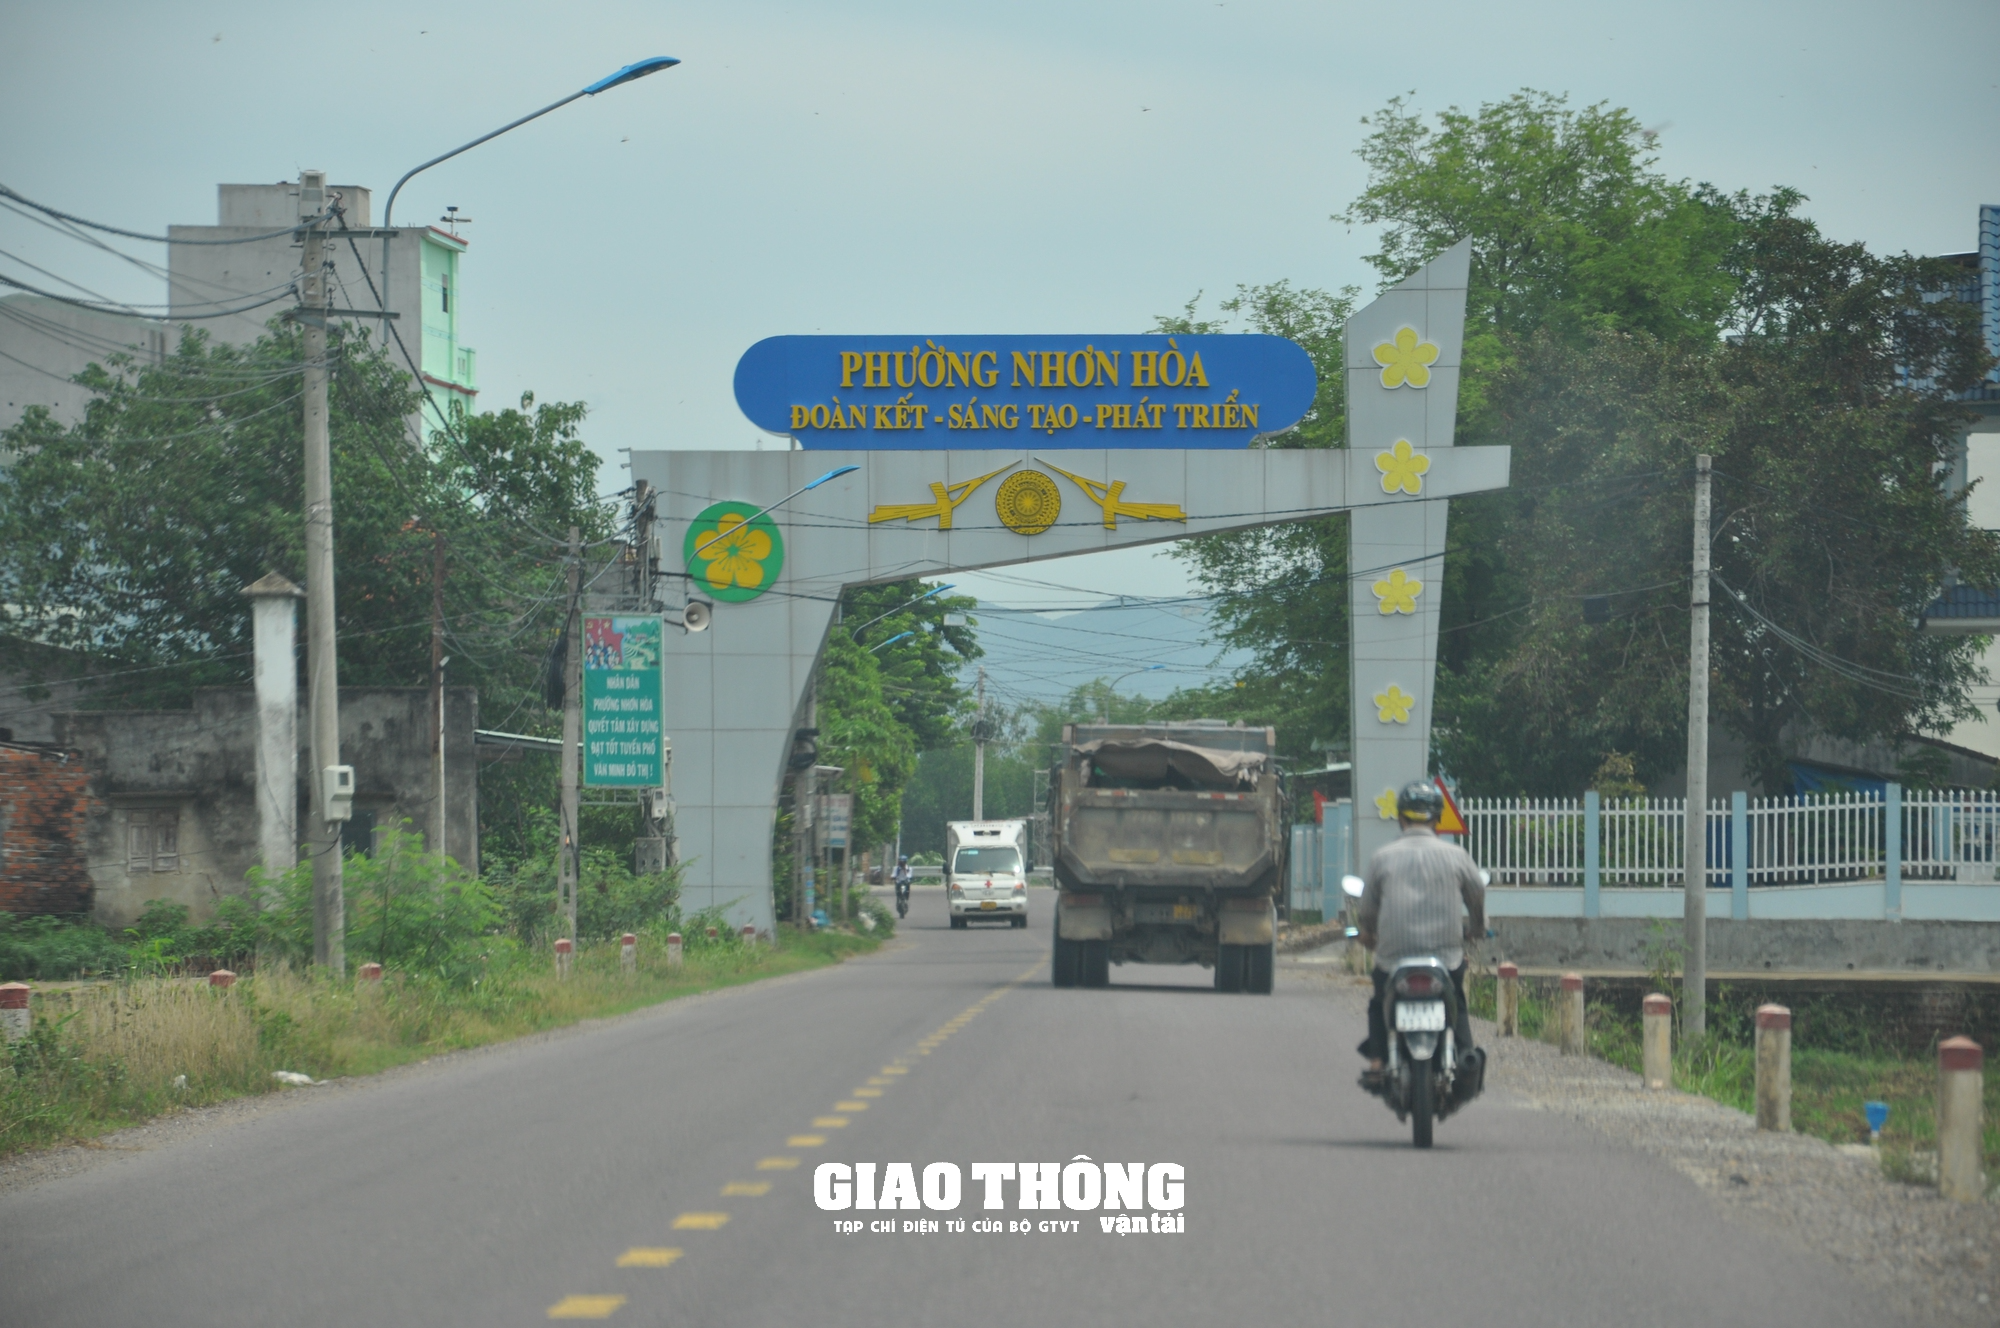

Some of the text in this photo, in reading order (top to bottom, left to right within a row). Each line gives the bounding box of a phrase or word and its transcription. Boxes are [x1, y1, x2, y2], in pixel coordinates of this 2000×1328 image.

[840, 337, 1209, 387] PHƯỜNG NHƠN HÒA
[790, 396, 867, 429] ĐOÀN
[873, 392, 928, 429] KẾT
[948, 396, 1019, 429] SÁNG
[1027, 404, 1078, 435] TẠO
[1095, 396, 1166, 429] PHÁT
[1173, 389, 1260, 429] TRIỂN
[593, 695, 619, 711] PHƯỜNG
[639, 696, 653, 711] HÒA
[588, 715, 659, 735] QUYẾT TÂM XÂY DỰNG
[591, 737, 657, 757] ĐẠT TỐT TUYẾN PHỐ
[594, 761, 607, 777] VĂN
[608, 764, 625, 777] MINH
